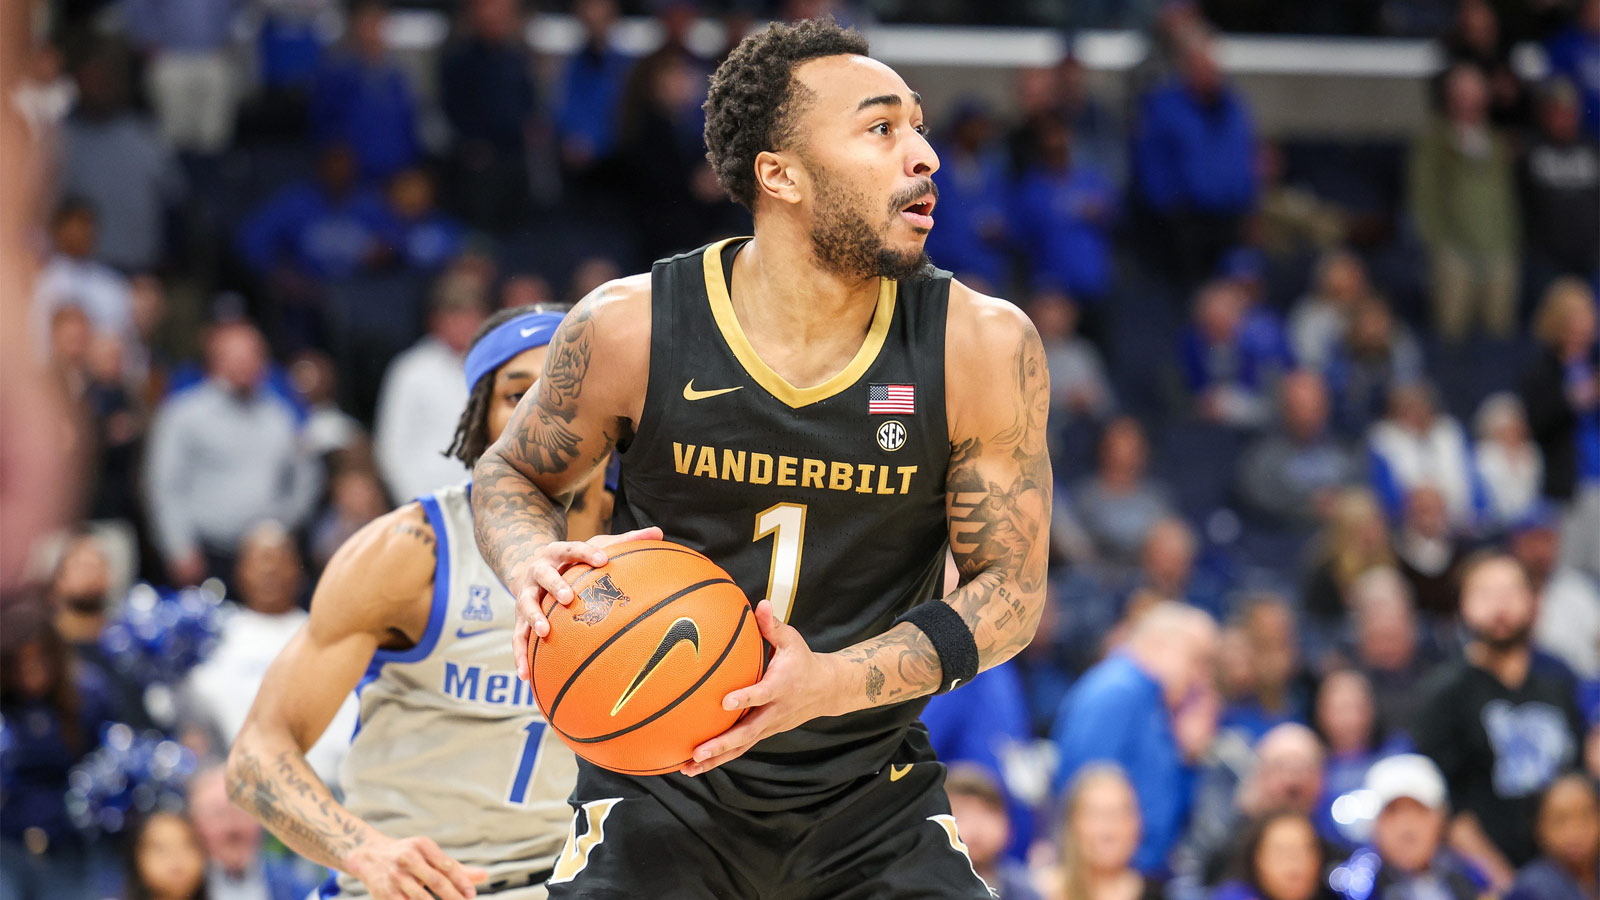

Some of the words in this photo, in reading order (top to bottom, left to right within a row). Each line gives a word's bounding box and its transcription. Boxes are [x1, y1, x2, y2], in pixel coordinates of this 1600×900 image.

[673, 442, 918, 495] VANDERBILT
[879, 422, 905, 449] SEC
[753, 502, 808, 624] 1
[508, 721, 548, 804] 1
